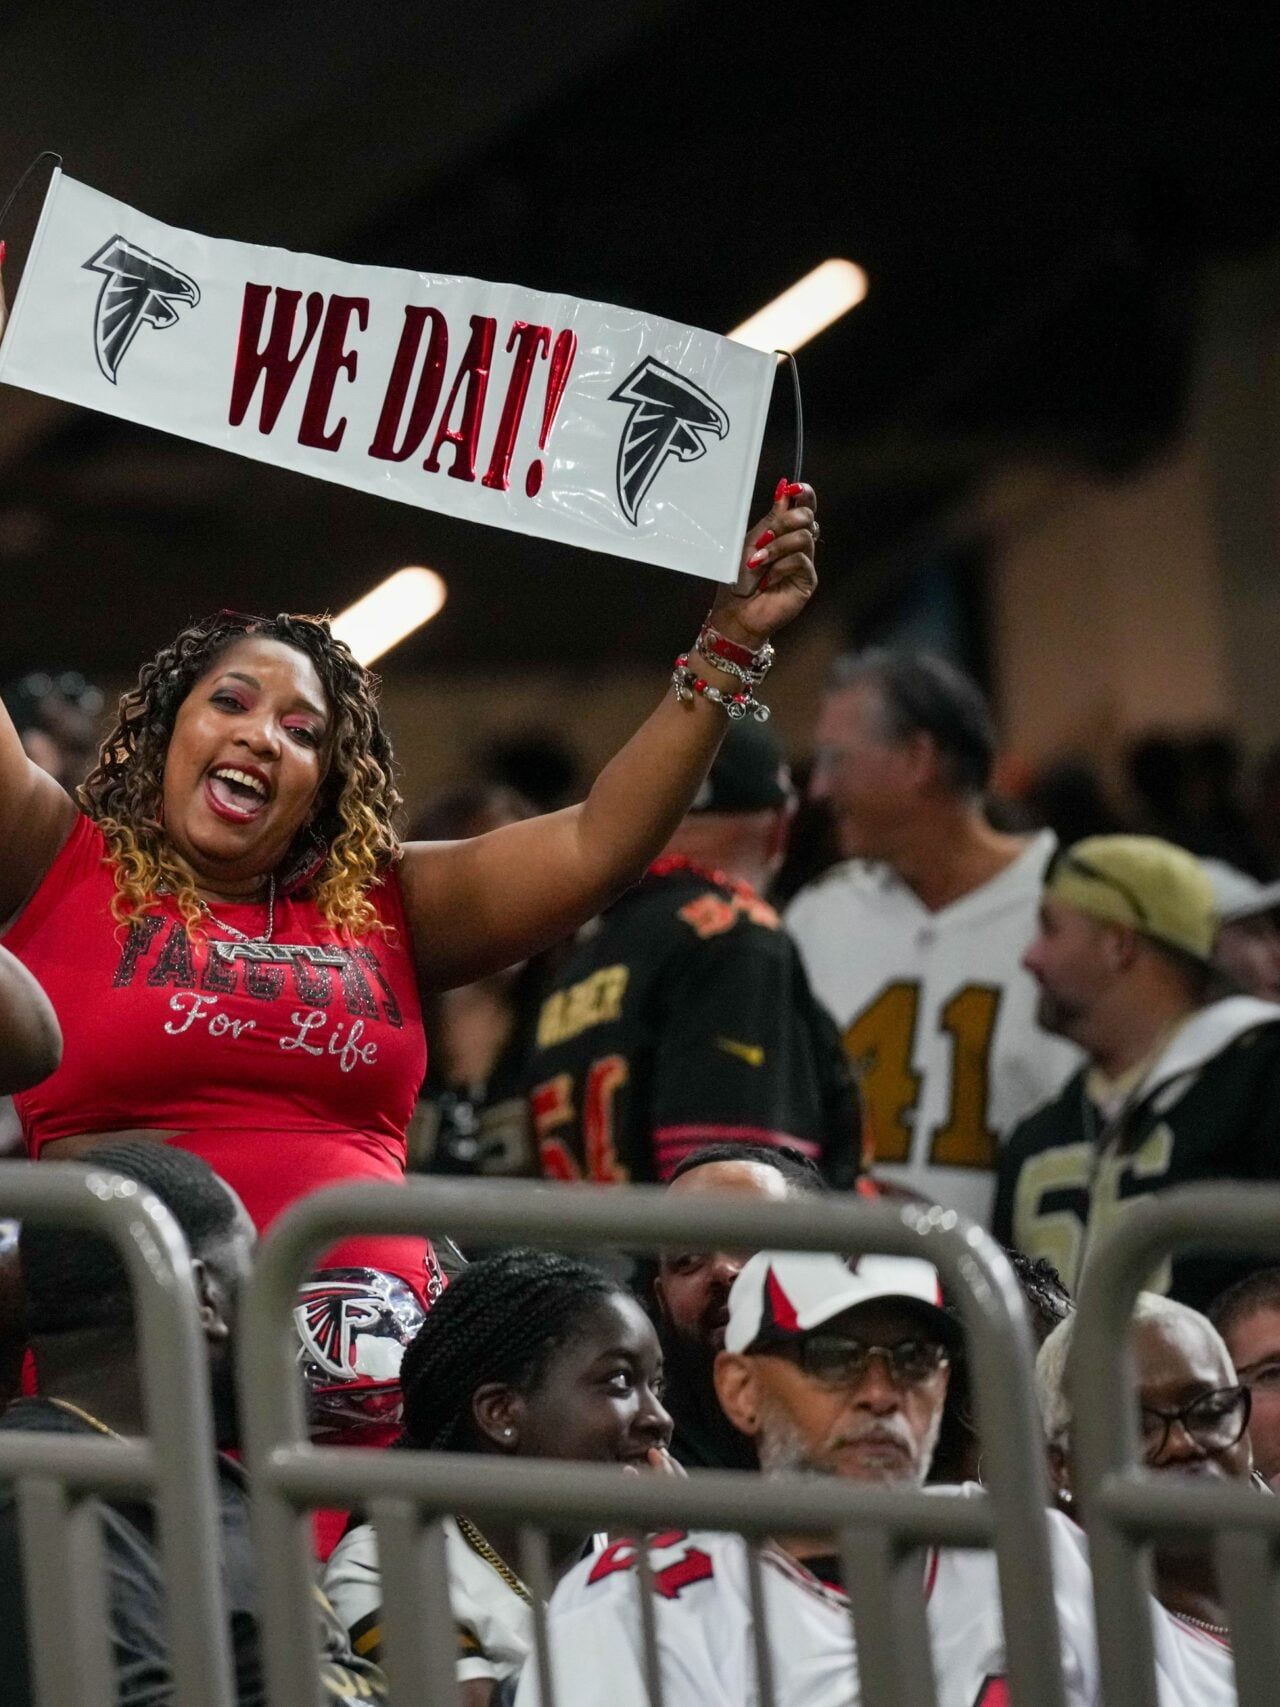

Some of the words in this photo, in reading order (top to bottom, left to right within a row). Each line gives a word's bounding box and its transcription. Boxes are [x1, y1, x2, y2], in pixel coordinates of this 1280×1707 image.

[228, 281, 370, 451] WE
[368, 303, 578, 499] DAT!
[163, 991, 257, 1036] For
[279, 1010, 379, 1073] Life
[839, 975, 1002, 1168] 41
